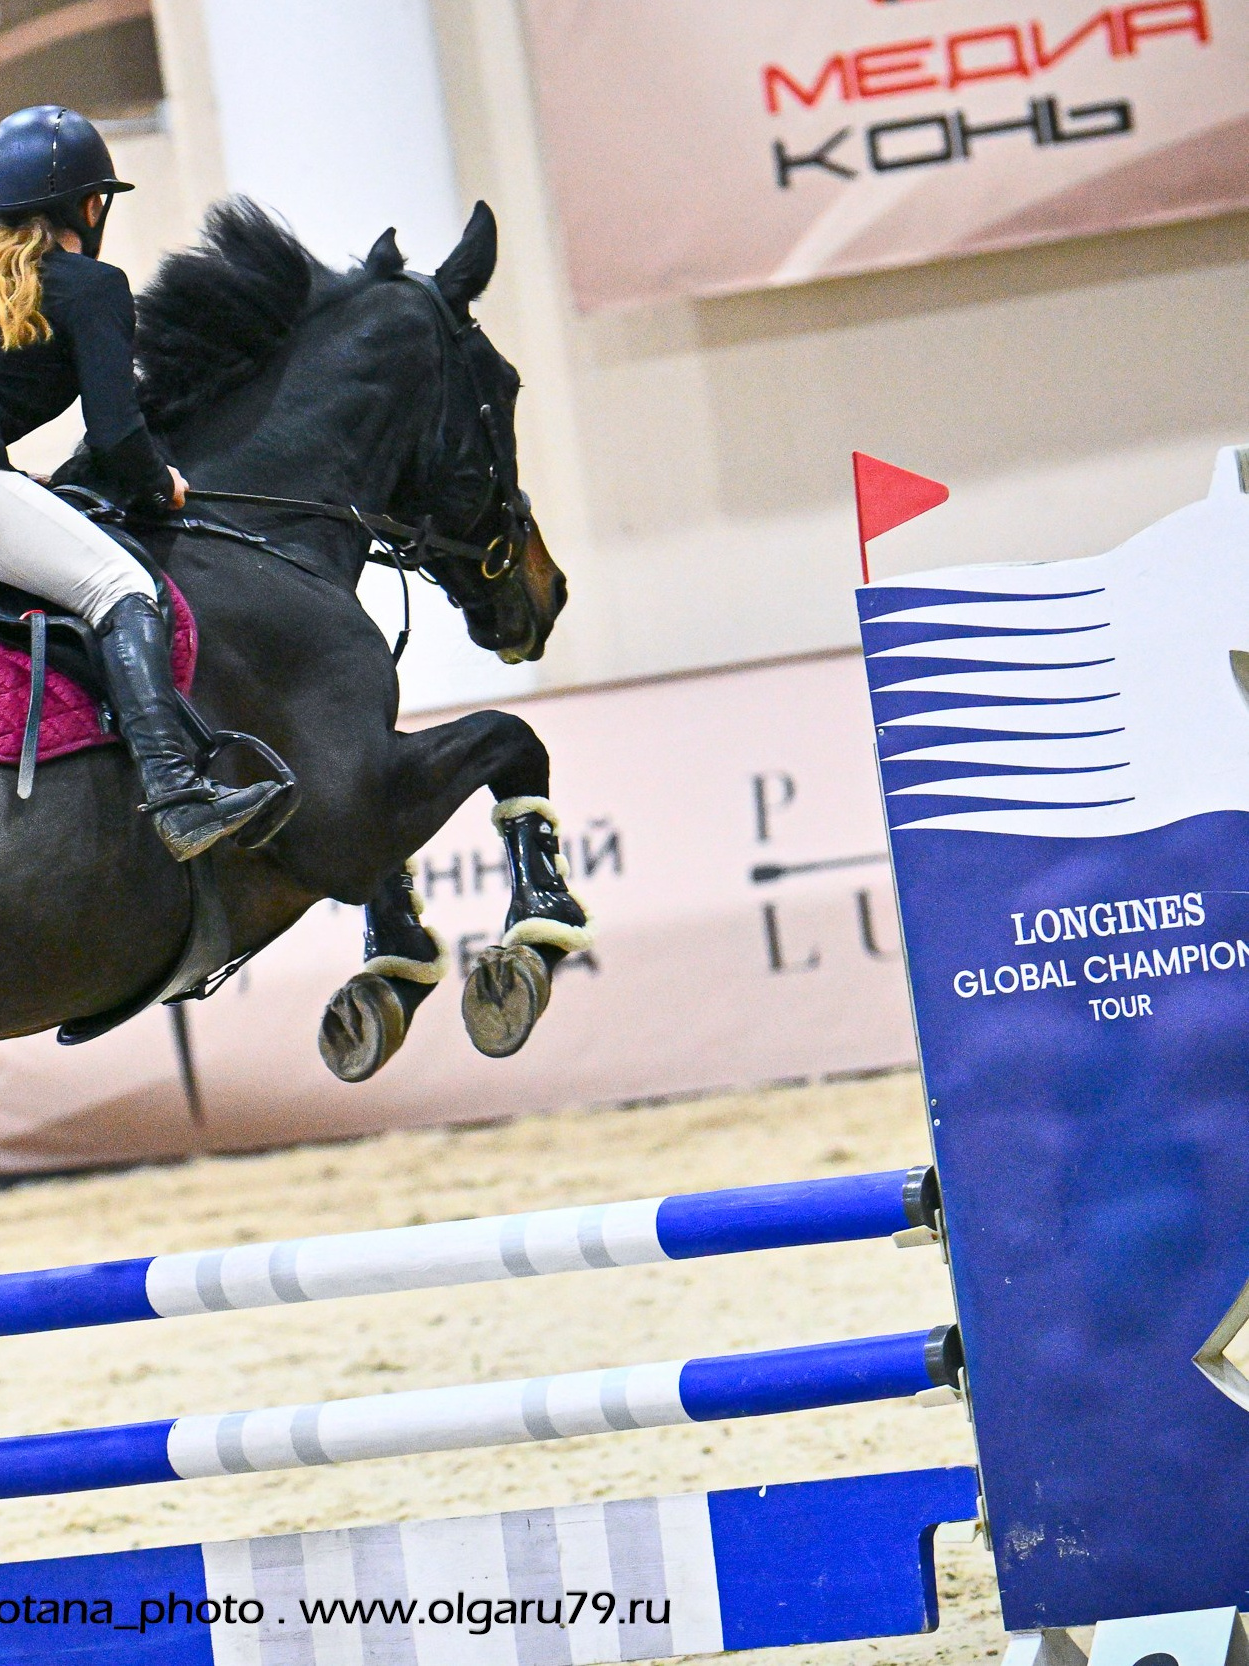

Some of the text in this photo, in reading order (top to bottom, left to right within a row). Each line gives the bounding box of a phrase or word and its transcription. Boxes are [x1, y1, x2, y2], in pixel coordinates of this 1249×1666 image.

[772, 94, 1134, 189] КОНЬ
[1010, 892, 1206, 946] LONGINES
[953, 959, 1077, 999] GLOBAL
[1088, 994, 1153, 1022] TOUR
